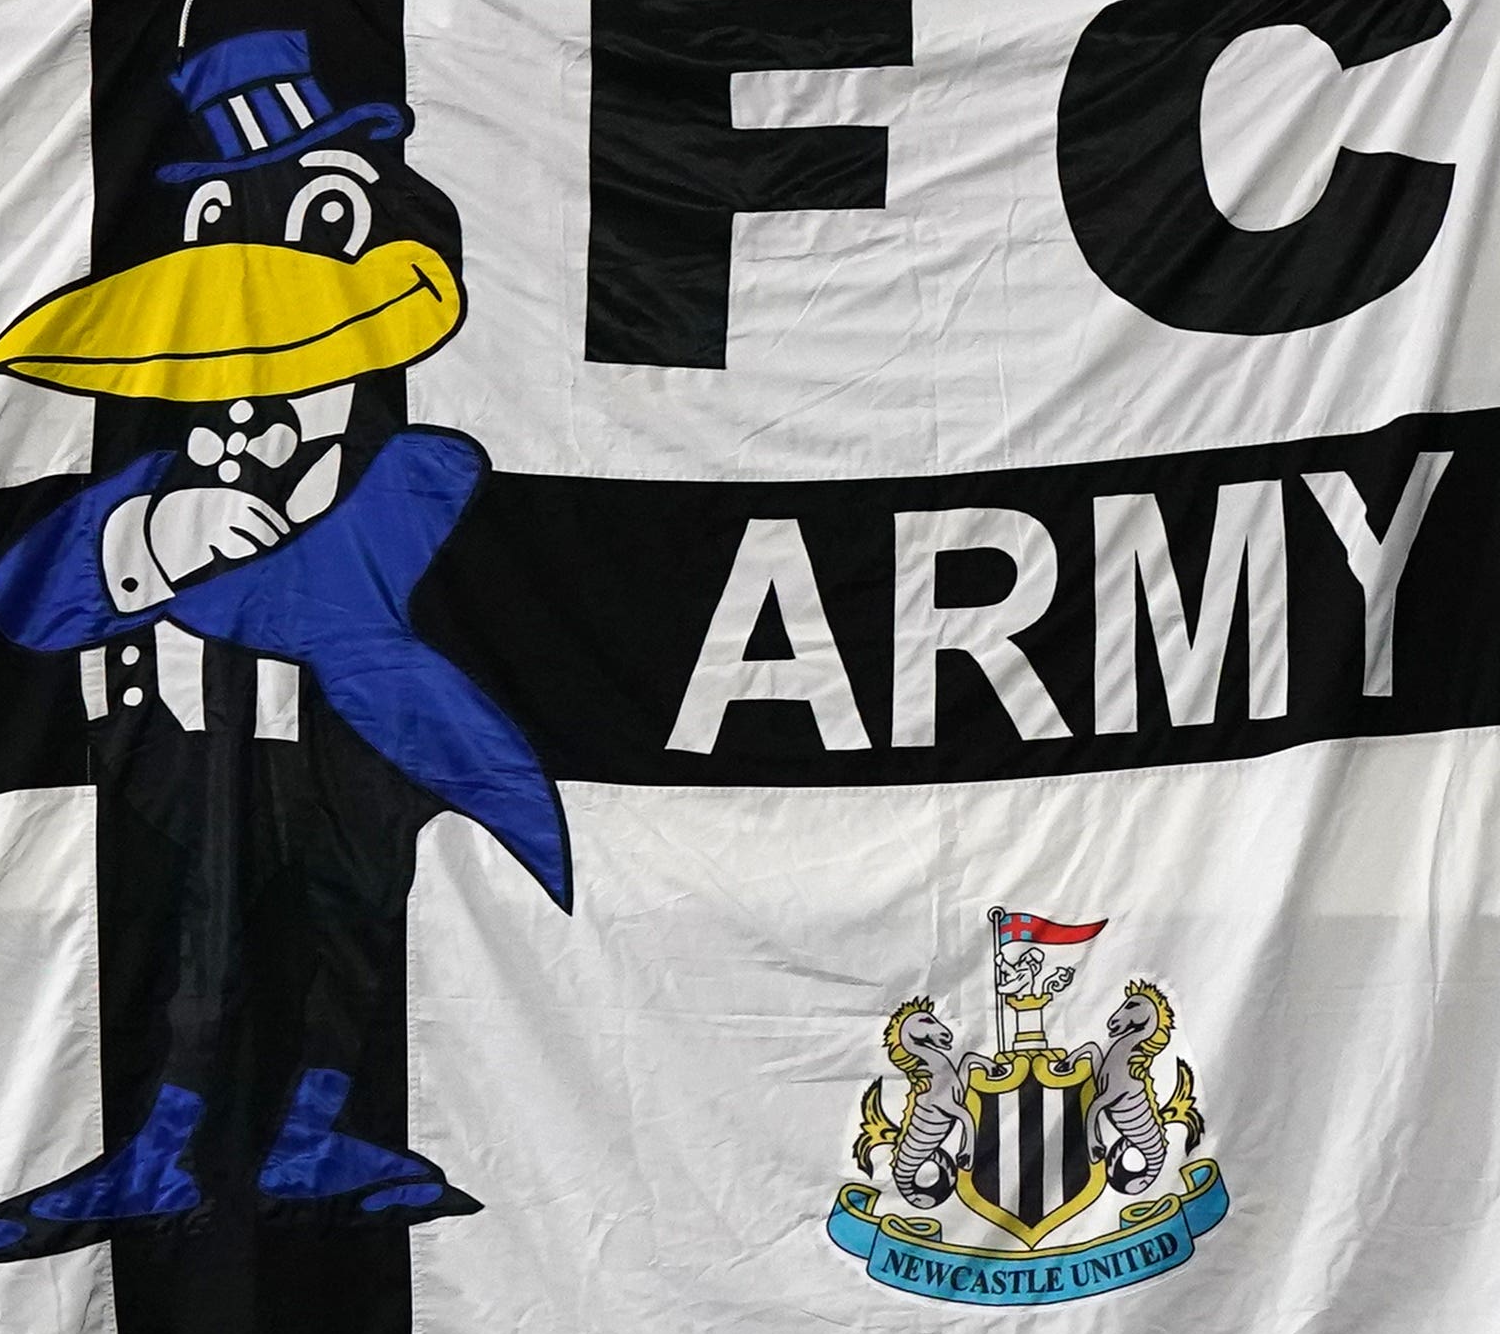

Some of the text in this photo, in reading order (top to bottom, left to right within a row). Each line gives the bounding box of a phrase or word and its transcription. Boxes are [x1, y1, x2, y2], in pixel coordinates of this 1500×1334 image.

[664, 450, 1454, 755] ARMY
[881, 1232, 1179, 1294] NEWCASTLE UNITED
